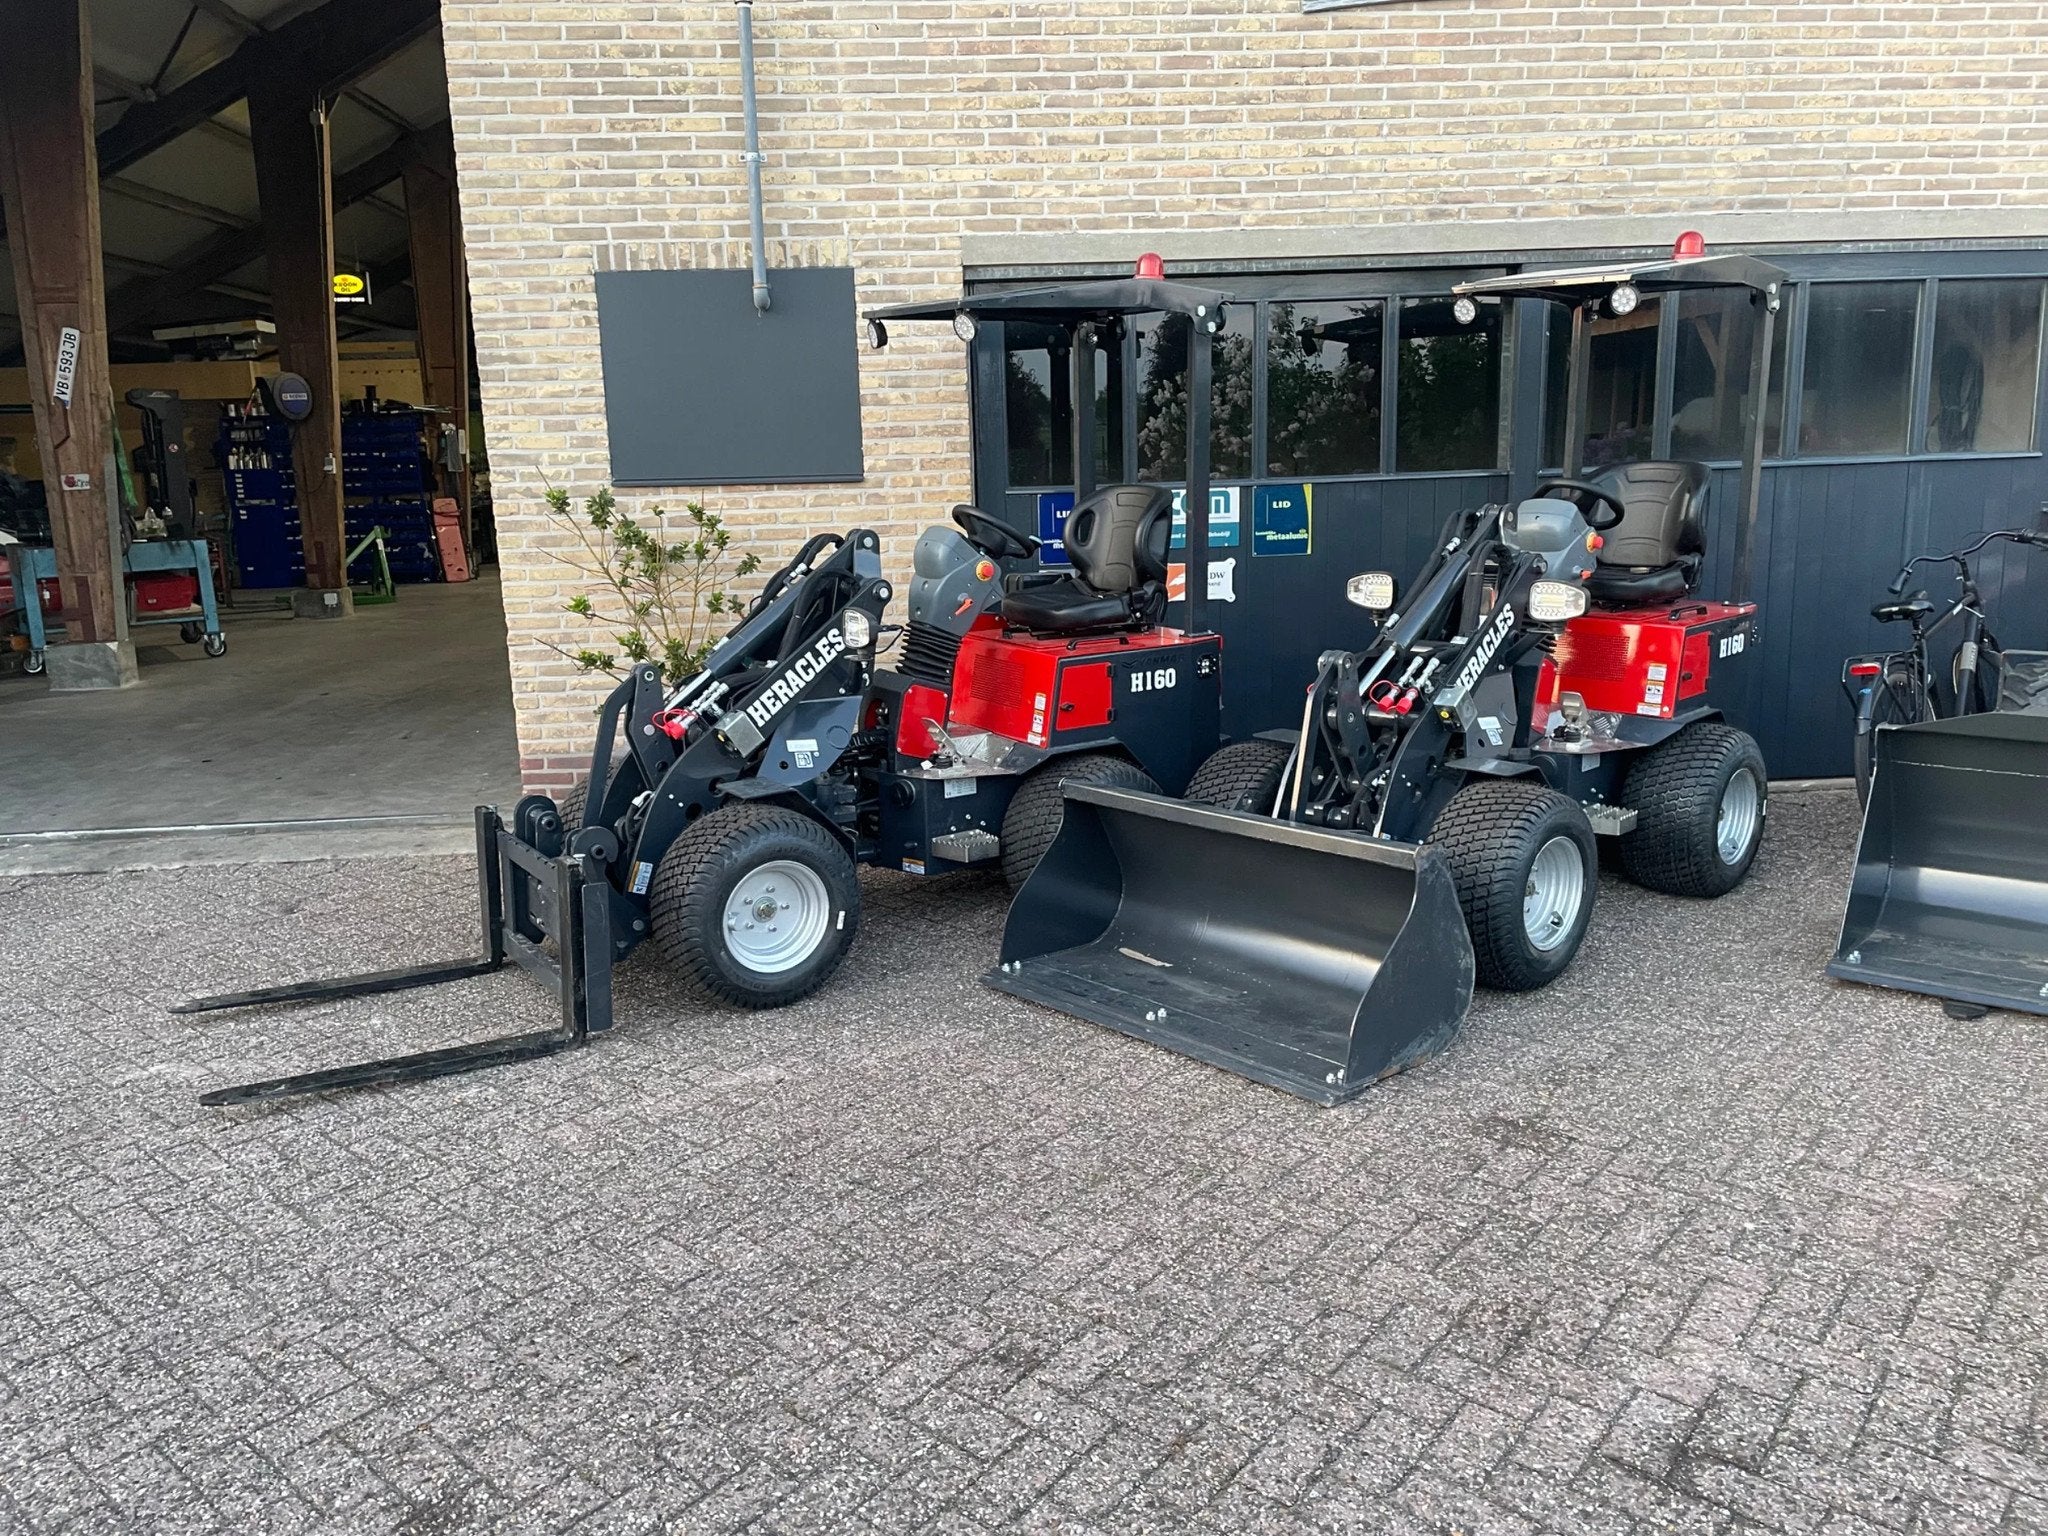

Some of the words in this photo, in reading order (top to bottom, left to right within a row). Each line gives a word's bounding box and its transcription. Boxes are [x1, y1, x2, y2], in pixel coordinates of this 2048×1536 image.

[63, 332, 78, 349] JB
[59, 350, 74, 374] 593
[1272, 500, 1292, 509] LID
[1207, 572, 1226, 580] DW
[745, 627, 847, 728] HERACLES
[1130, 667, 1177, 693] H160
